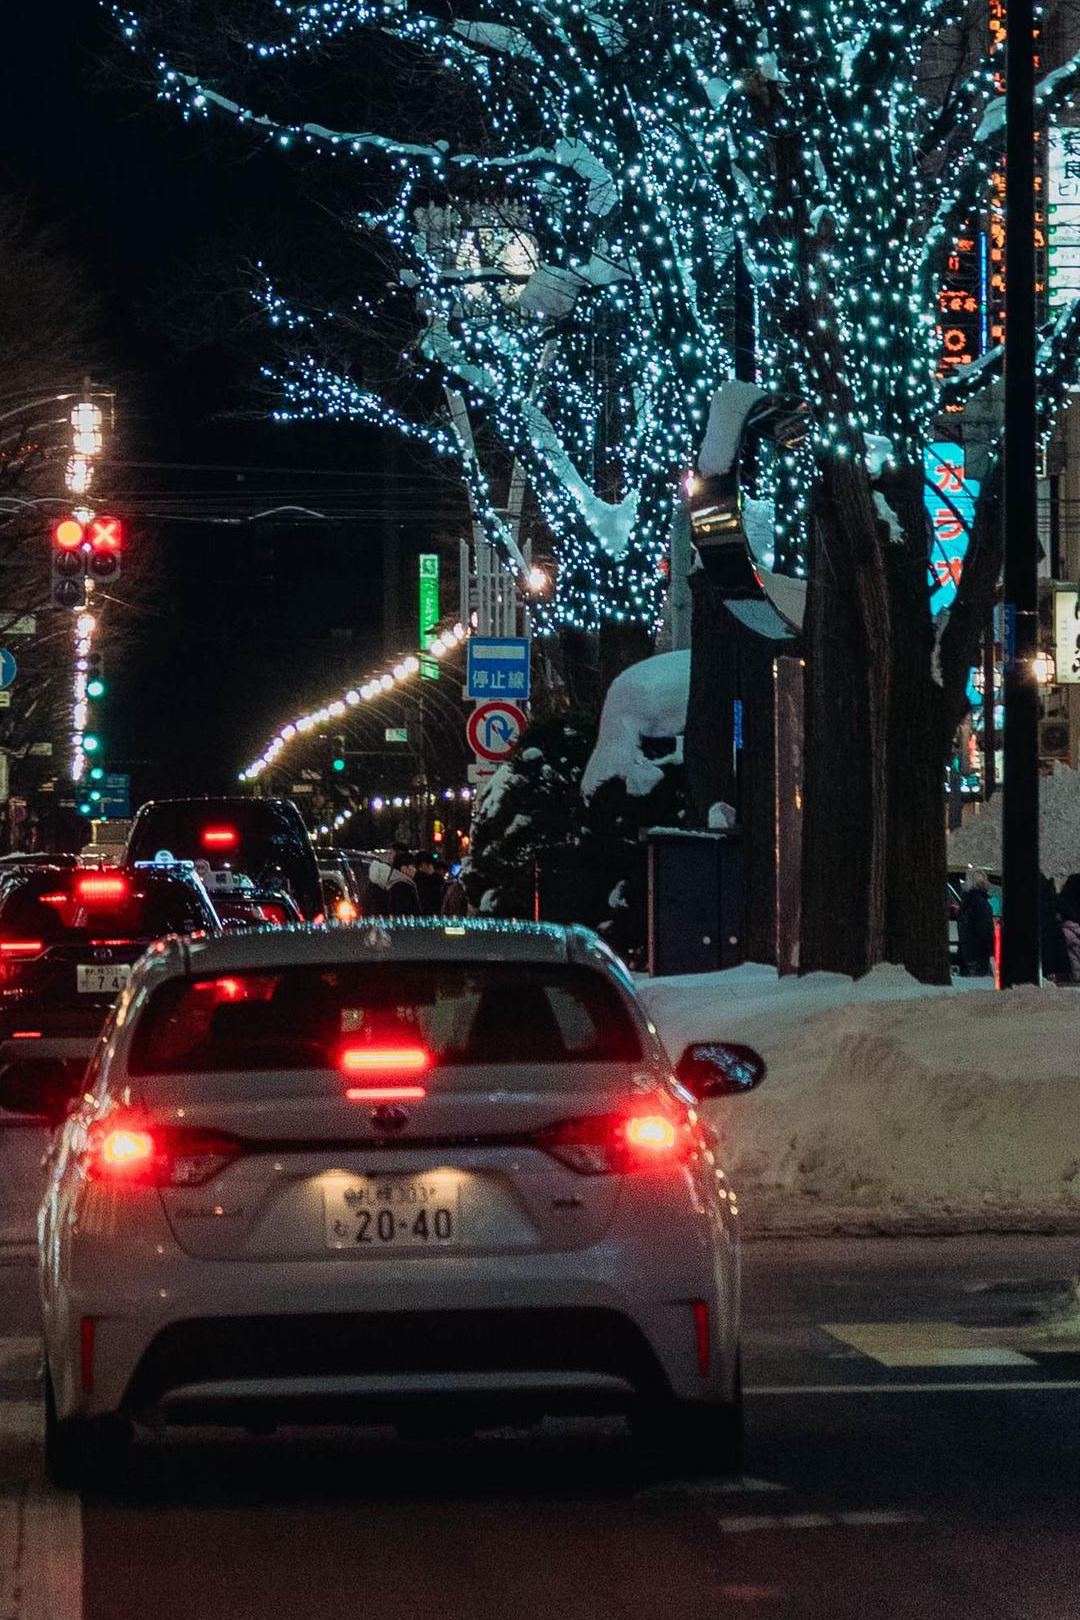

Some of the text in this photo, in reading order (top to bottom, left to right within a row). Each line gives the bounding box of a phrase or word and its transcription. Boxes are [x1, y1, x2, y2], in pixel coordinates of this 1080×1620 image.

[472, 670, 525, 690] 停止線
[355, 1208, 452, 1242] 20-40
